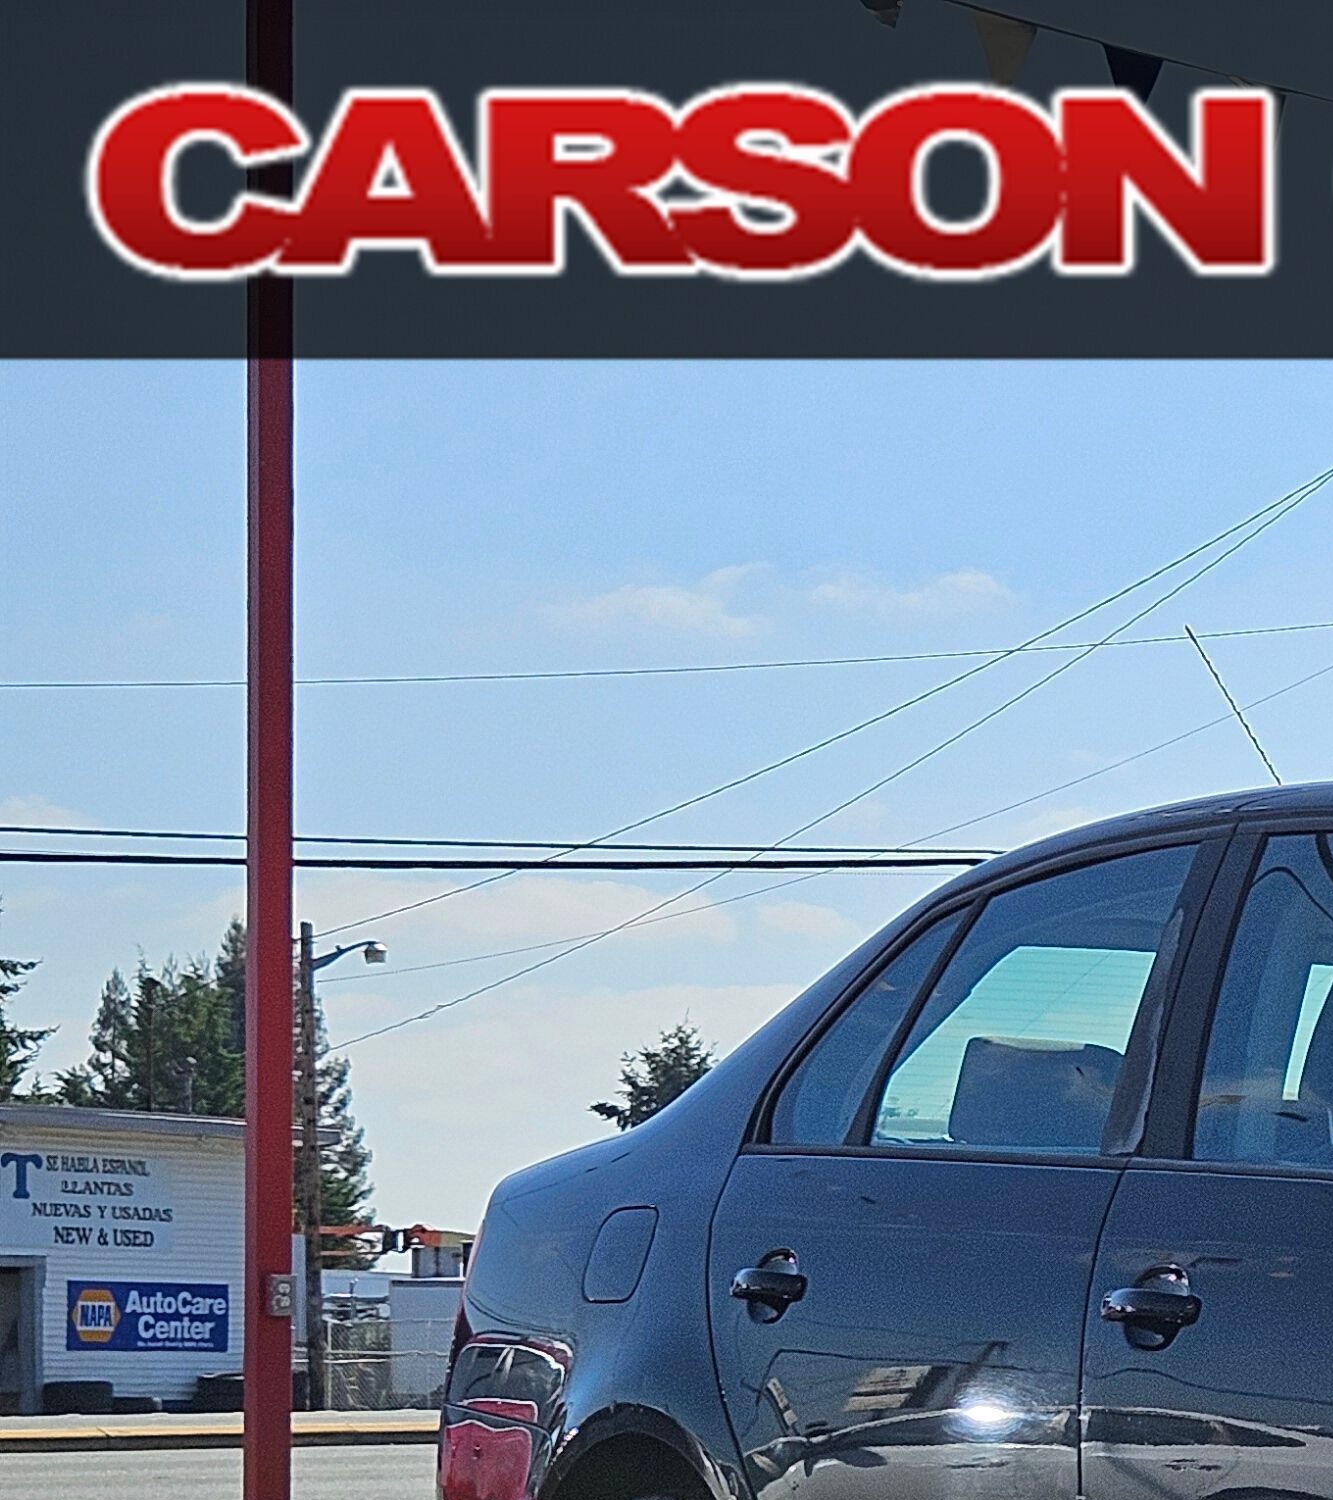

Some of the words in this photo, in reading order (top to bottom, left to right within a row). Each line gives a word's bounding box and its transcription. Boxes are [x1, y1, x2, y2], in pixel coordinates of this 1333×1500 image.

[46, 1155, 59, 1172] SE
[61, 1156, 99, 1174] HABLA
[61, 1180, 134, 1196] LLANTAS
[31, 1202, 91, 1219] NUEVAS
[96, 1205, 107, 1219] Y
[111, 1206, 173, 1223] USADAS
[53, 1226, 93, 1245] NEW
[98, 1228, 109, 1246] &
[113, 1229, 155, 1247] USED
[125, 1290, 227, 1315] AutoCare
[80, 1304, 112, 1327] NAPA
[138, 1315, 215, 1339] Center
